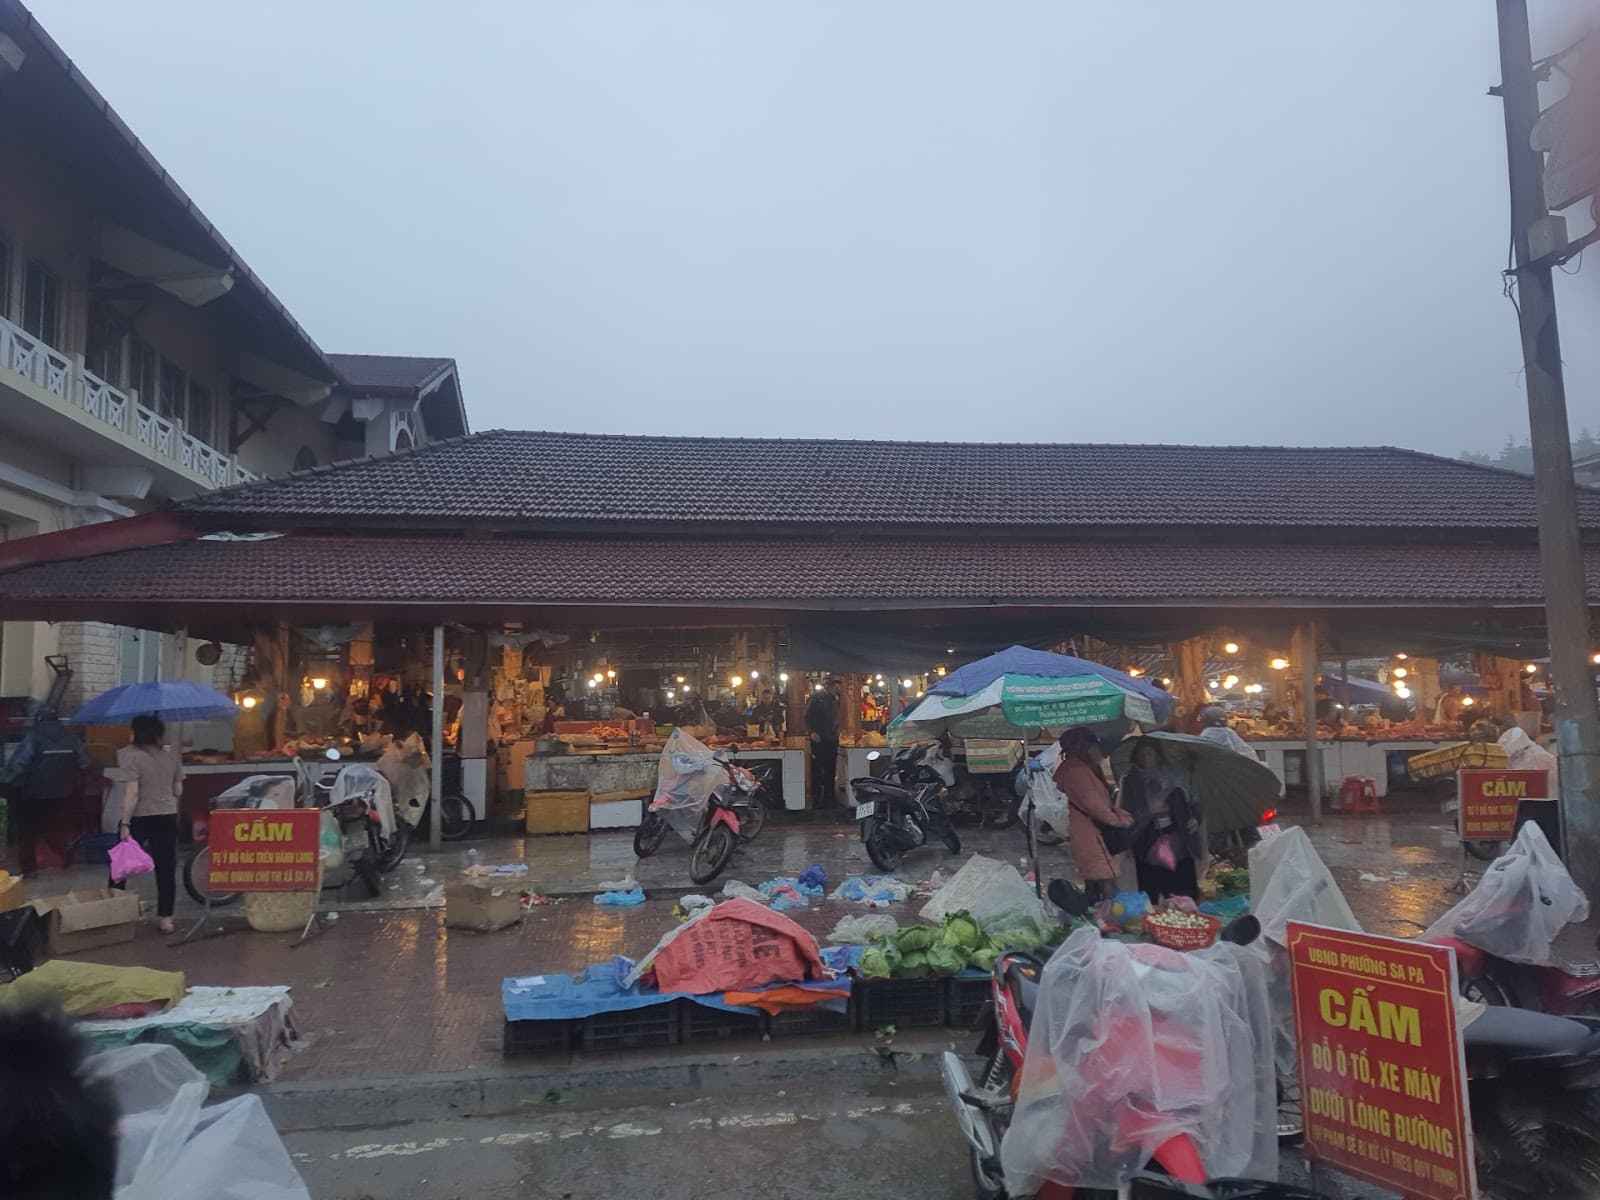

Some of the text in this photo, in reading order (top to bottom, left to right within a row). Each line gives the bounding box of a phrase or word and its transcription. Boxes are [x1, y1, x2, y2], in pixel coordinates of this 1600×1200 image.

[1481, 775, 1527, 797] CẤM
[234, 816, 293, 841] CẤM
[1309, 947, 1425, 984] UBND PHƯỜNG SA PA
[1319, 985, 1422, 1047] CẤM
[1336, 1044, 1347, 1077] Ô
[1378, 1060, 1400, 1093] XE
[1404, 1066, 1440, 1105] MÁY
[1348, 1095, 1391, 1138] LÒNG
[1394, 1111, 1454, 1159] ĐƯỜNG
